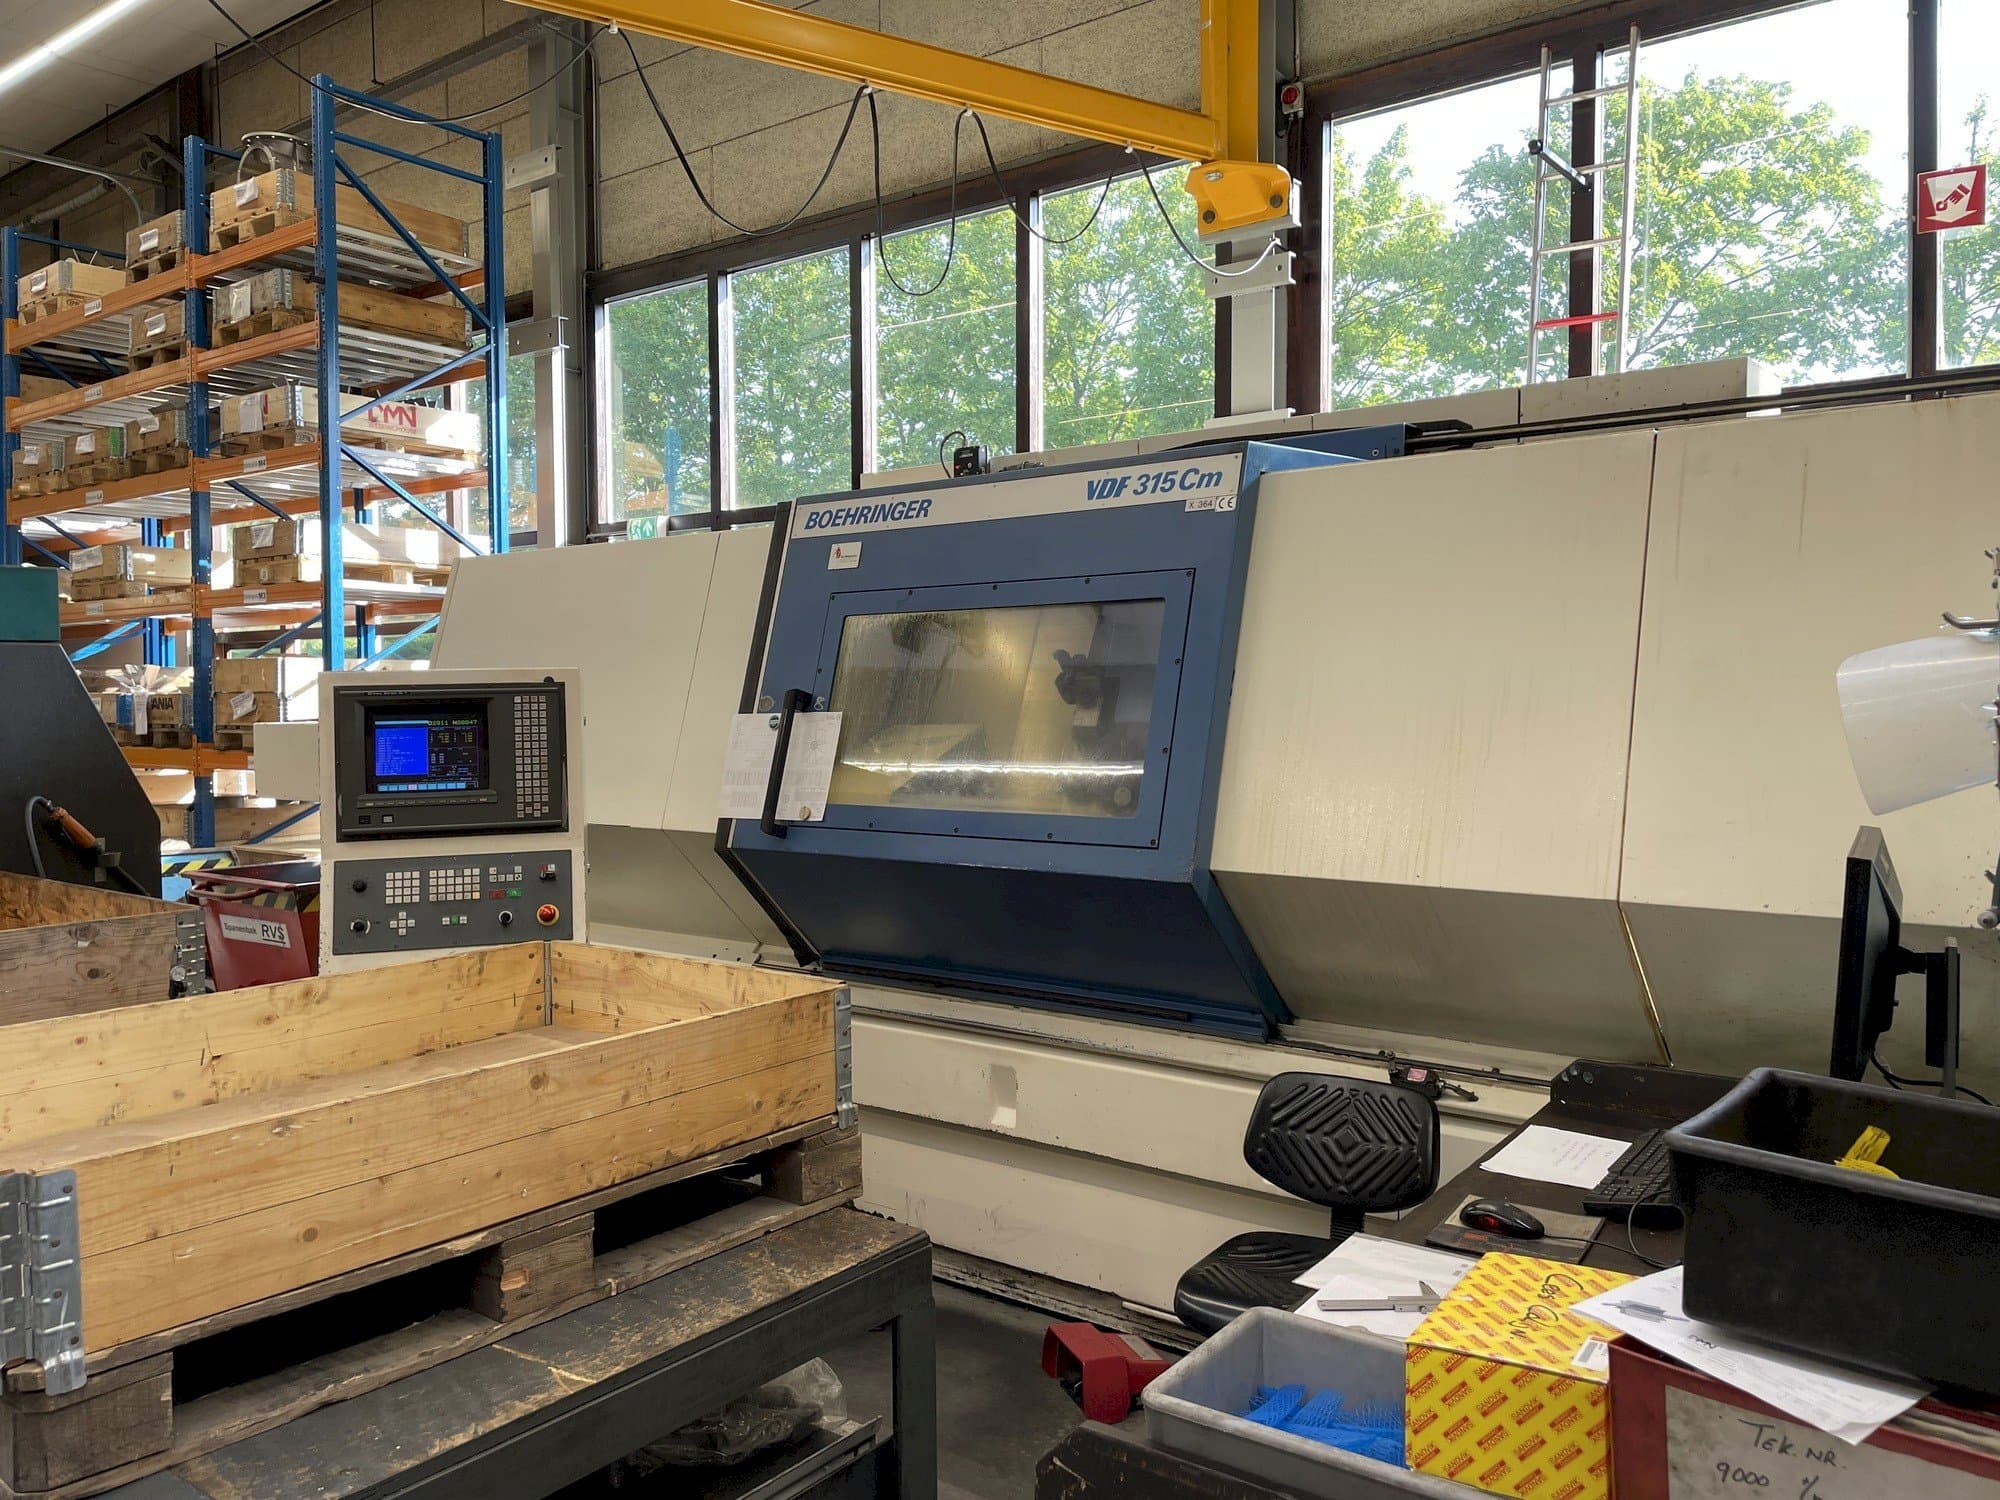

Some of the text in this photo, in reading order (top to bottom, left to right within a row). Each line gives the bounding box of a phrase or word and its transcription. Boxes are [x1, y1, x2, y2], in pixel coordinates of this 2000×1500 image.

[1087, 476, 1131, 501] VDF
[804, 498, 933, 530] BOEHRINGER
[1197, 499, 1213, 509] 364
[151, 697, 174, 710] ANIA
[261, 923, 285, 941] RVS
[1476, 1388, 1504, 1412] SANDVIK
[1510, 1395, 1540, 1421] SANDVIK
[1716, 1461, 1771, 1487] 9000
